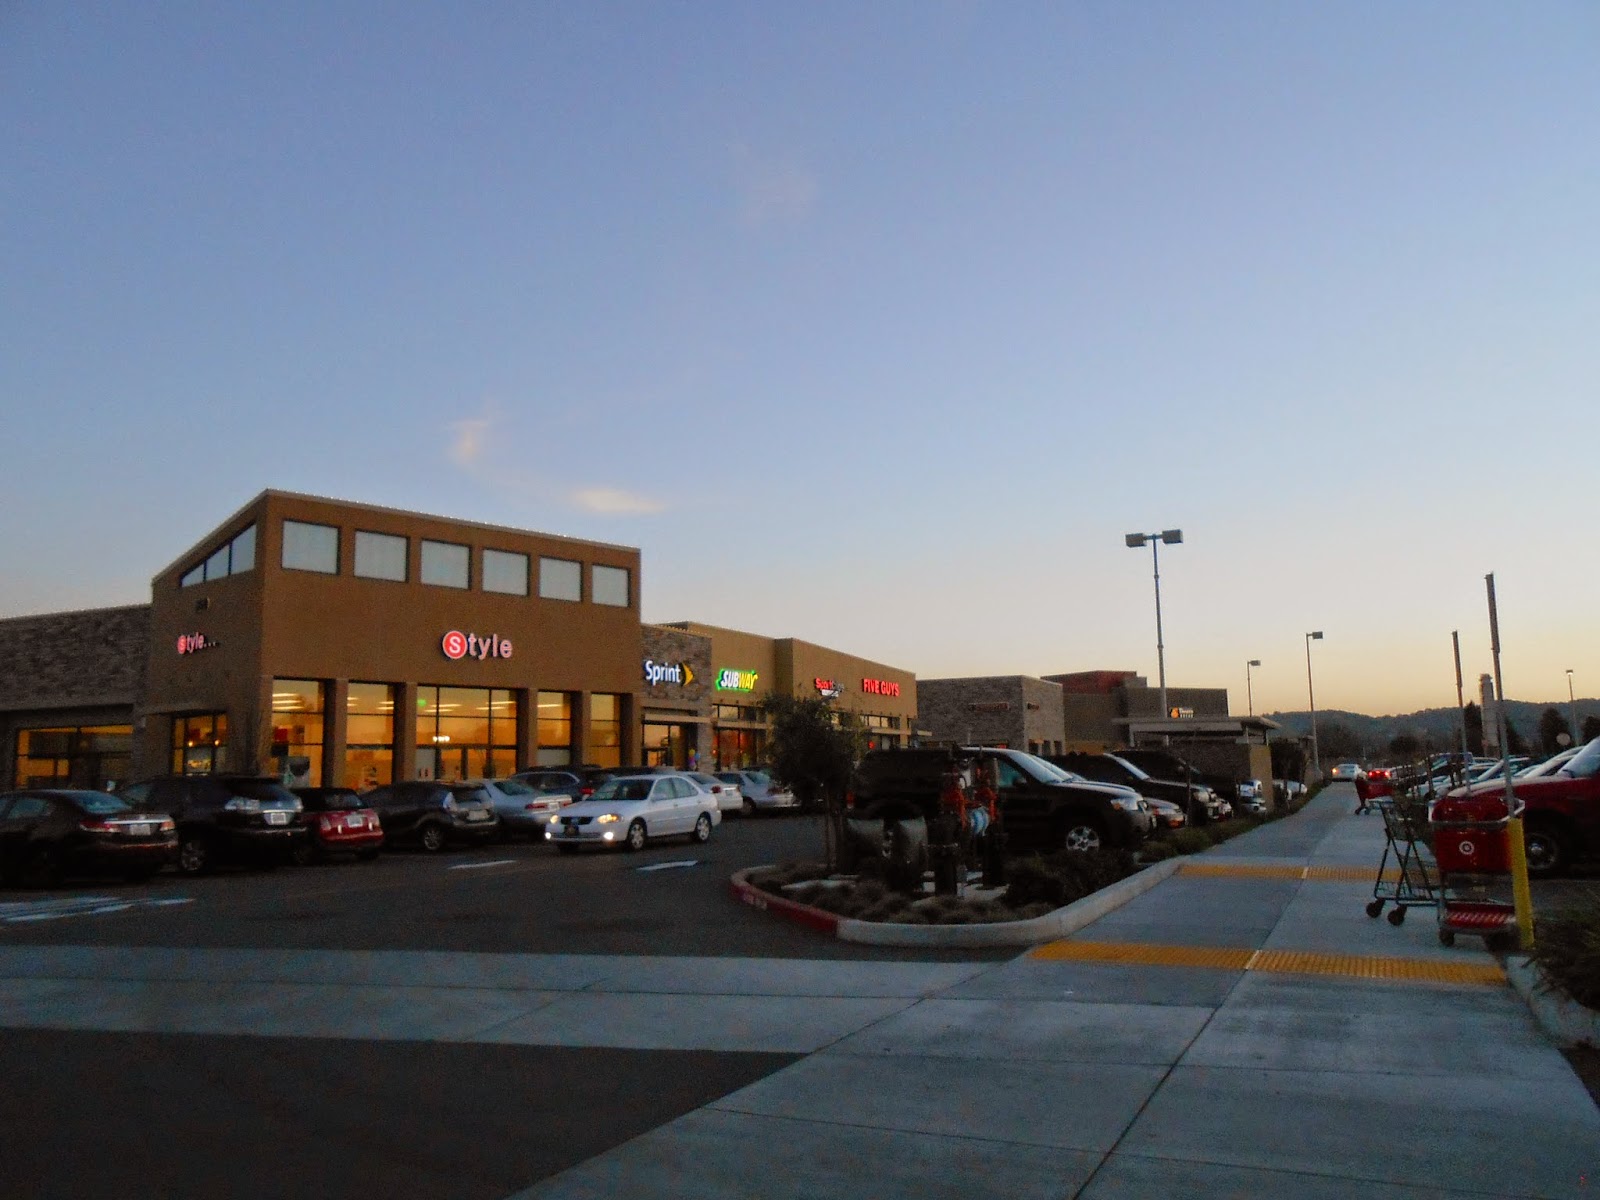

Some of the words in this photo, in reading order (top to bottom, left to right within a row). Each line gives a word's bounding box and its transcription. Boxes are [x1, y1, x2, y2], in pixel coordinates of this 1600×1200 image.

[442, 630, 513, 660] Style
[644, 659, 681, 687] Sprint
[719, 670, 759, 690] SUBWAY
[863, 678, 880, 694] FIVE
[880, 680, 901, 697] GUYS
